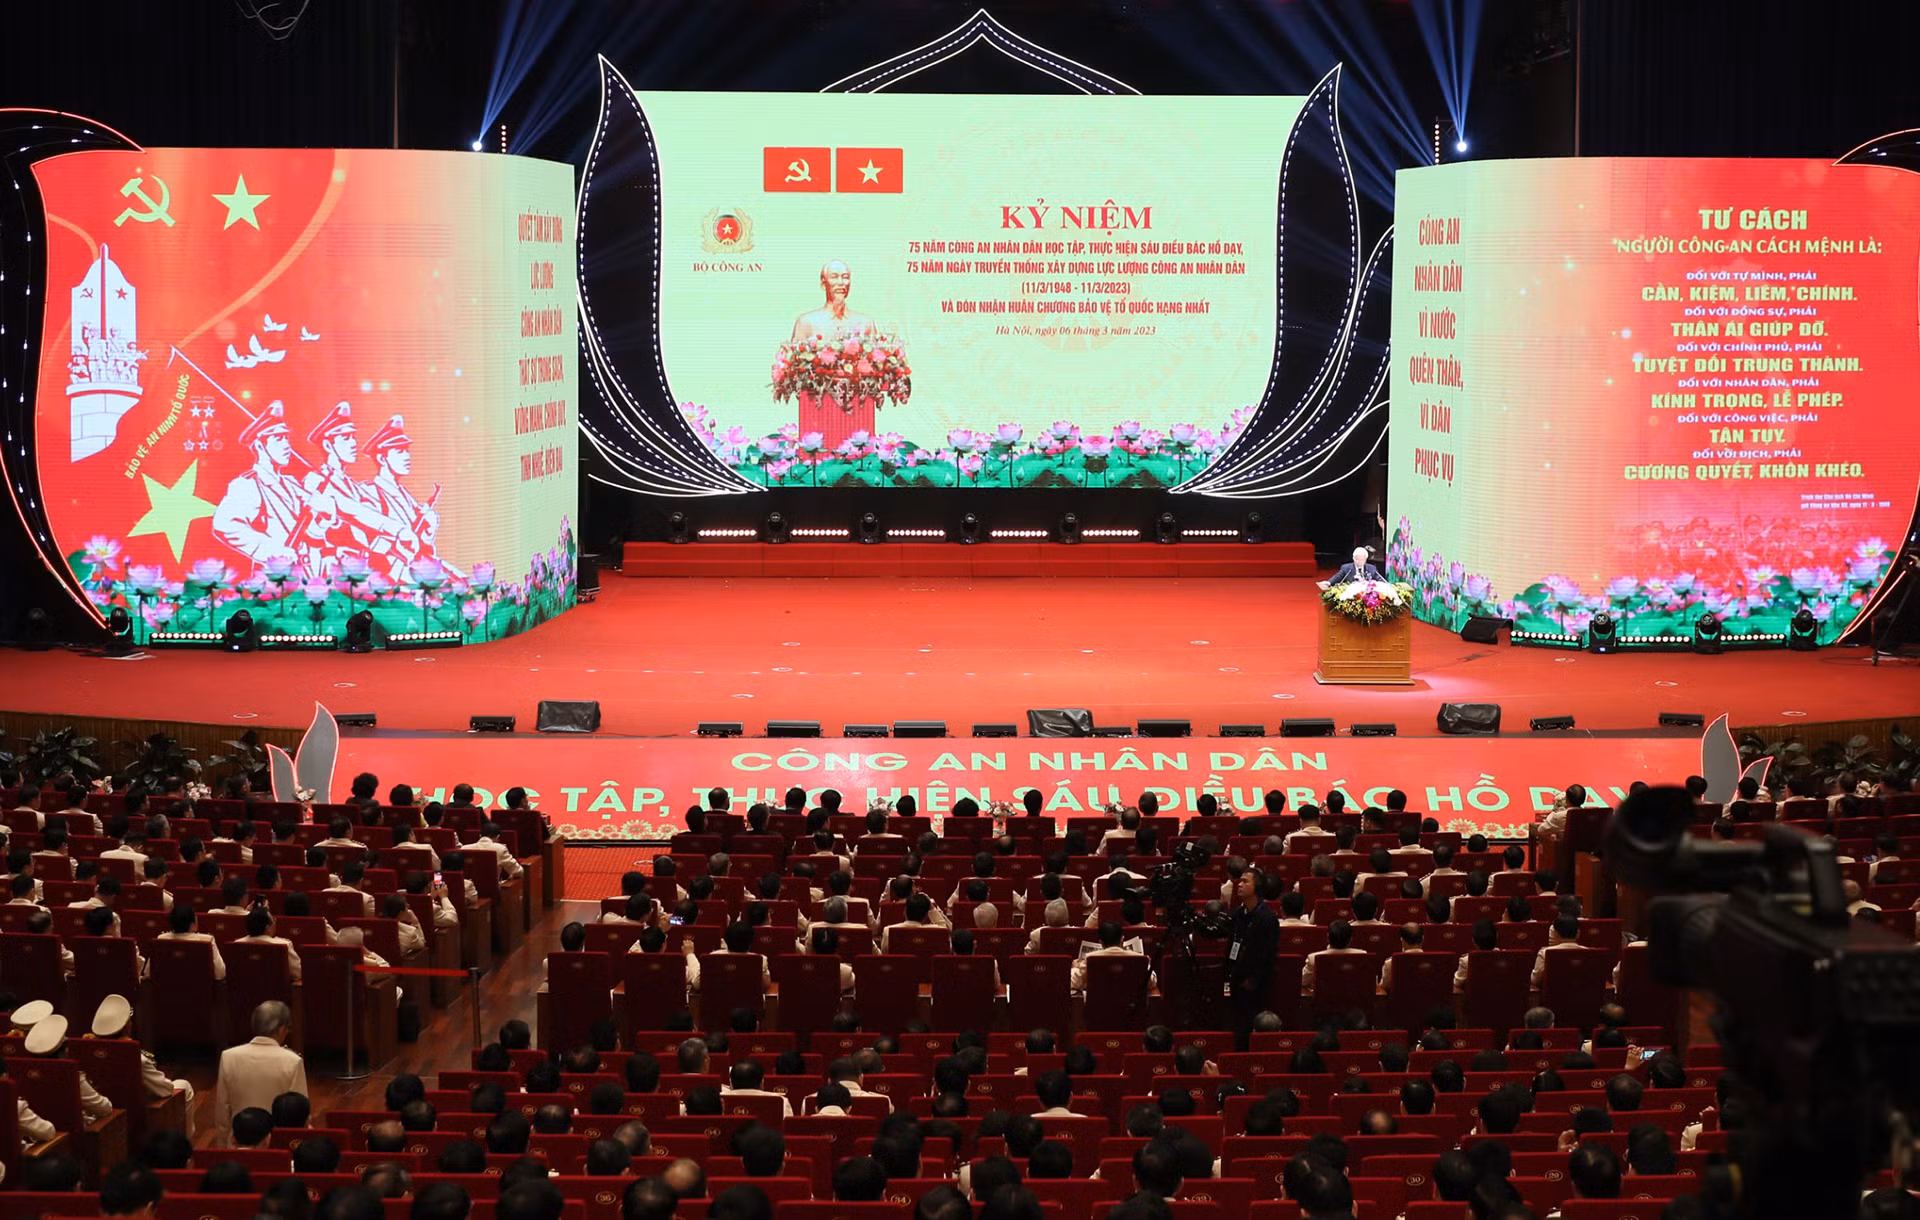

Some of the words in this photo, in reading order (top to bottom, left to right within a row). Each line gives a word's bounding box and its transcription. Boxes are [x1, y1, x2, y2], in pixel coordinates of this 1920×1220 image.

[1060, 199, 1152, 236] NIỆM
[1698, 206, 1734, 230] TƯ
[1739, 207, 1808, 230] CÁCH
[1419, 213, 1444, 246] CÔNG
[1446, 218, 1460, 245] AN
[909, 242, 920, 253] 75
[923, 240, 945, 253] NĂM
[949, 240, 974, 253] CÔNG
[977, 242, 990, 253] AN
[993, 240, 1020, 254] NHÂN
[1022, 240, 1042, 254] DÂN
[1045, 242, 1064, 256] HỌC
[1089, 241, 1113, 256] THỰC
[1115, 240, 1138, 256] HIỆN
[1186, 240, 1205, 254] BÁC
[1756, 236, 1800, 253] CÁCH
[1805, 236, 1854, 256] MỆNH
[1858, 236, 1882, 254] LÀ:
[907, 261, 919, 273] 75
[921, 260, 943, 273] NĂM
[946, 259, 971, 273] NGÀY
[974, 258, 1011, 273] TRUYỀN
[1013, 258, 1045, 273] THỐNG
[1047, 260, 1066, 274] XÂY
[1068, 261, 1094, 276] DỰNG
[1097, 261, 1115, 276] LỰC
[1117, 261, 1149, 276] LƯỢNG
[1151, 260, 1177, 274] CÔNG
[1180, 262, 1194, 274] AN
[1196, 260, 1223, 274] NHÂN
[1225, 260, 1245, 274] DÂN
[1414, 259, 1440, 292] NHÂN
[1443, 259, 1462, 292] DÂN
[1686, 269, 1708, 280] ĐỐI
[1710, 270, 1731, 280] VỚI
[1733, 271, 1749, 282] TỰ
[1789, 270, 1817, 280] PHẢI
[1021, 282, 1072, 294] (11/3/1948
[1081, 282, 1131, 294] 11/3/2023)
[1641, 282, 1684, 302] CẦN,
[1690, 284, 1740, 303] KIỆM,
[1745, 284, 1790, 302] LIÊM,
[1796, 284, 1858, 301] CHÍNH.
[941, 299, 953, 313] VÀ
[956, 299, 976, 313] ĐÓN
[979, 299, 1006, 315] NHẬN
[1008, 299, 1034, 313] HUÂN
[1037, 300, 1076, 313] CHƯƠNG
[1078, 298, 1097, 313] BẢO
[1100, 299, 1111, 316] VỆ
[1128, 298, 1155, 314] QUỐC
[1156, 301, 1182, 316] HẠNG
[1185, 297, 1210, 313] NHẤT
[1684, 305, 1706, 316] ĐỐI
[1708, 306, 1728, 316] VỚI
[1789, 305, 1817, 316] PHẢI
[1419, 306, 1428, 337] VÌ
[1430, 306, 1456, 339] NƯỚC
[1670, 320, 1719, 336] THÂN
[1725, 320, 1744, 336] ÁI
[1750, 320, 1793, 336] GIÚP
[1676, 341, 1698, 352] ĐỐI
[1700, 342, 1721, 352] VỚI
[1723, 341, 1762, 352] CHÍNH
[1795, 341, 1822, 352] PHẢI
[1410, 351, 1434, 385] QUÊN
[1437, 353, 1464, 391] THÂN,
[1633, 356, 1689, 375] TUYỆT
[1694, 354, 1727, 372] ĐỐI
[1732, 358, 1793, 372] TRUNG
[1799, 355, 1863, 372] THÀNH.
[1678, 377, 1699, 387] ĐỐI
[1702, 377, 1722, 387] VỚI
[1725, 377, 1759, 387] NHÂN
[1792, 376, 1819, 387] PHẢI
[1651, 392, 1696, 408] KÍNH
[1702, 393, 1767, 410] TRỌNG,
[1773, 388, 1791, 407] LỄ
[1797, 391, 1843, 407] PHÉP.
[1420, 398, 1428, 430] VÌ
[1431, 400, 1450, 433] DÂN
[1677, 412, 1699, 423] ĐỐI
[1701, 413, 1722, 422] VỚI
[1724, 413, 1757, 422] CÔNG
[1790, 412, 1818, 422] PHẢI
[1709, 426, 1744, 446] TẬN
[1750, 428, 1785, 446] TỤY.
[1692, 448, 1714, 459] ĐỐI
[1739, 449, 1772, 460] ĐỊCH,
[1774, 448, 1802, 458] PHẢI
[1415, 448, 1439, 483] PHỤC
[1442, 452, 1454, 487] VỤ
[1624, 463, 1689, 479] CƯƠNG
[1760, 462, 1809, 478] KHÔN
[1815, 461, 1865, 478] KHÉO.
[731, 747, 909, 771] CÔNG
[928, 752, 1006, 771] AN
[1029, 747, 1189, 771] NHÂN
[1209, 747, 1328, 771] DÂN
[560, 780, 670, 819] TẬP,
[1425, 773, 1510, 812] HỒ
